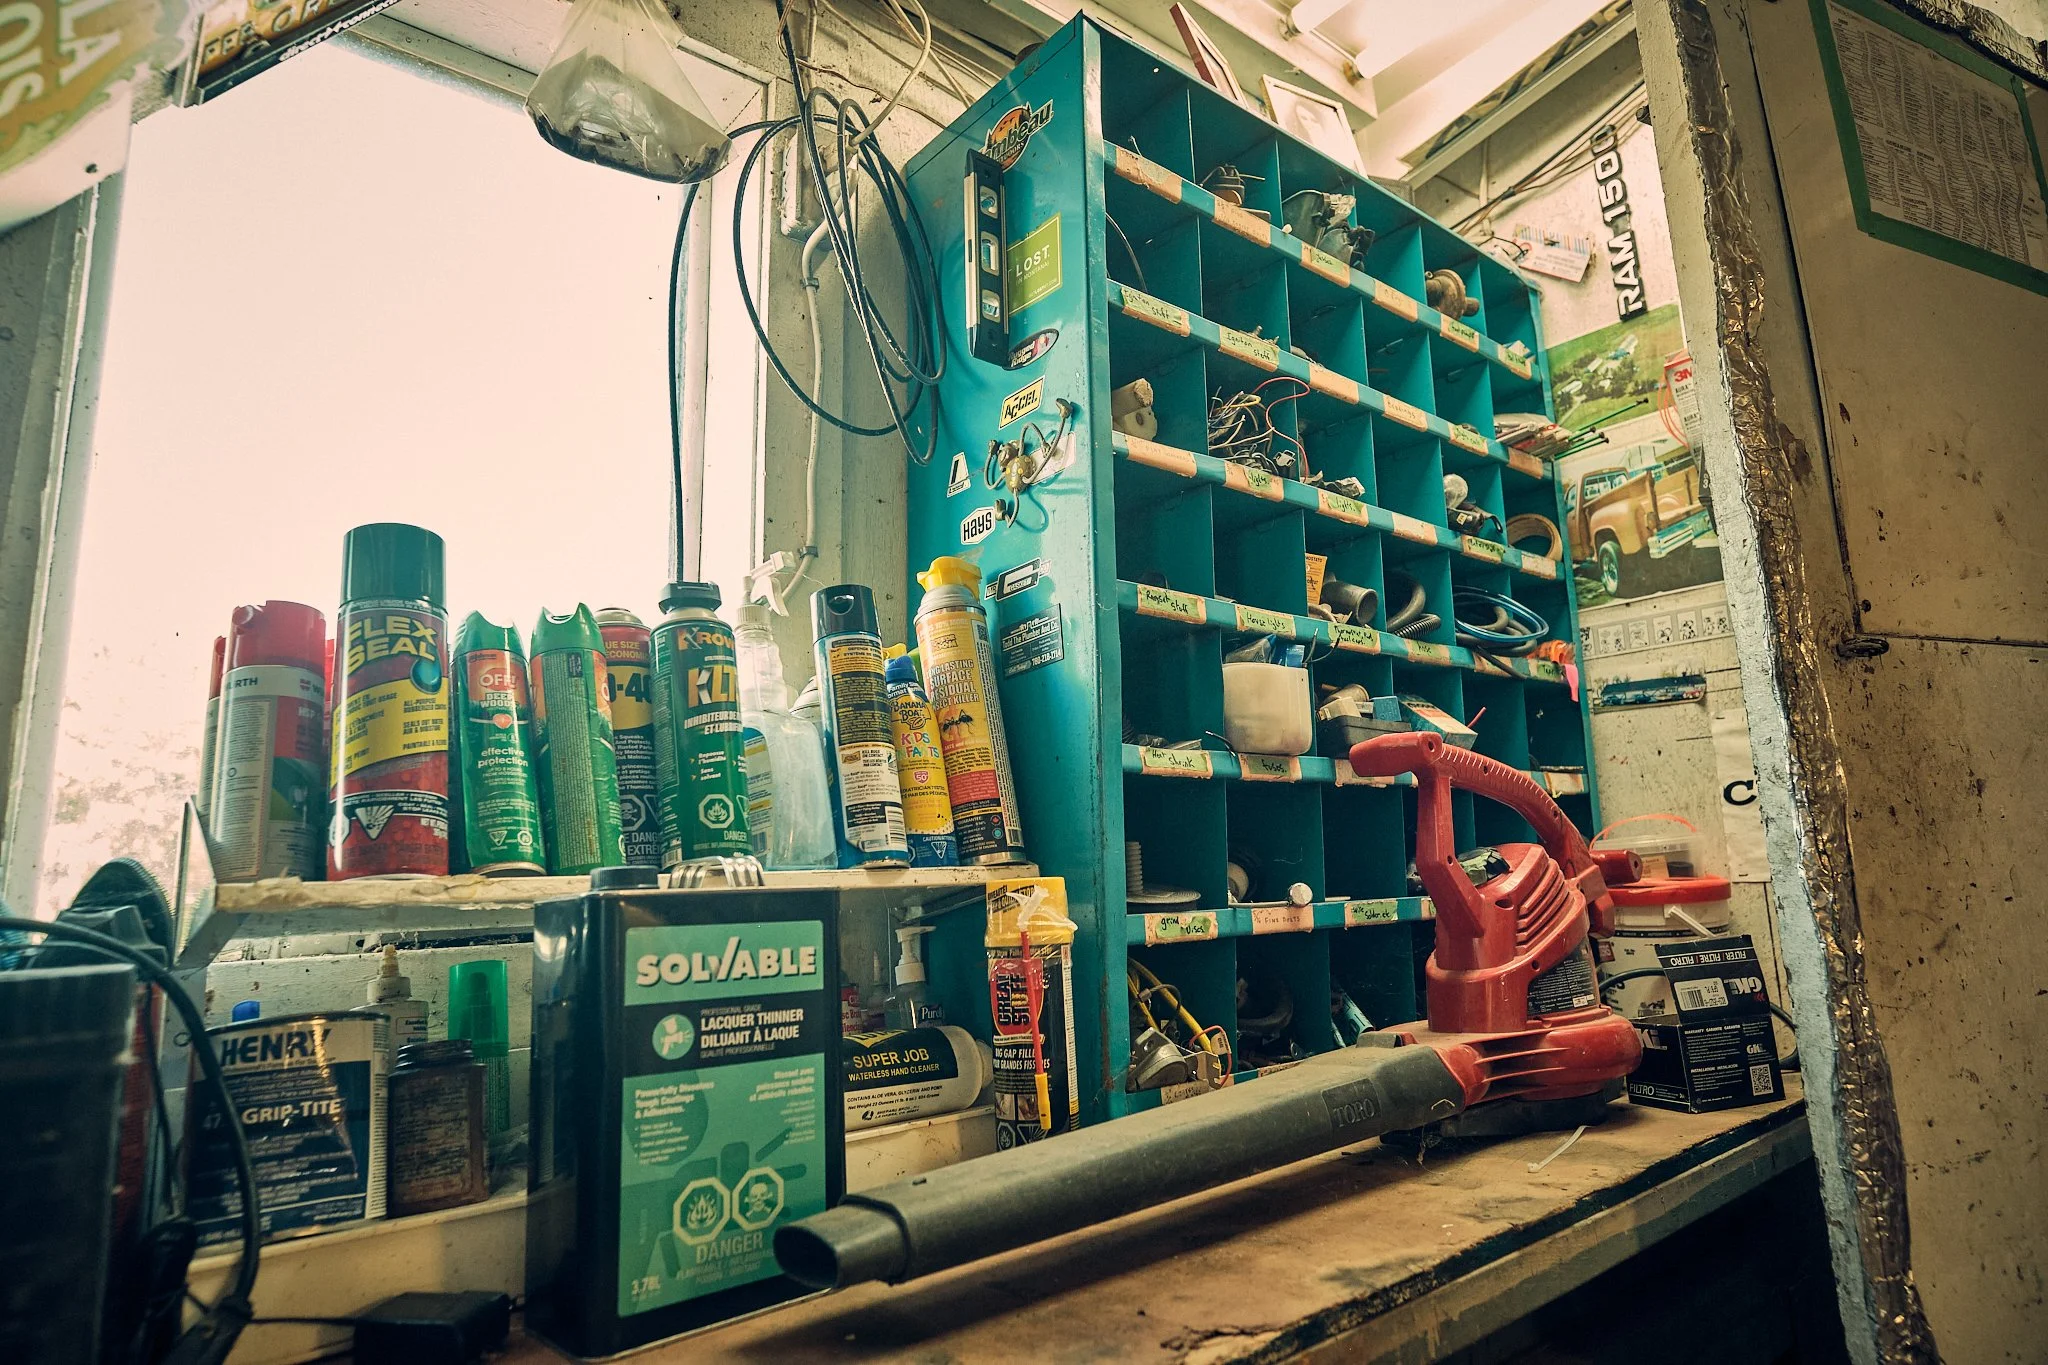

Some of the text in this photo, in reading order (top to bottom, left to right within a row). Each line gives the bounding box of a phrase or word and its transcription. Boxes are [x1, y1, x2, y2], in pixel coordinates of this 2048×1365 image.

[1608, 231, 1643, 316] RAM
[349, 615, 437, 646] FLEX
[620, 641, 641, 650] SIZE
[347, 637, 436, 676] SEAL
[941, 659, 974, 672] LASTING
[480, 673, 517, 688] OFF!
[931, 669, 972, 689] SURFACE
[887, 689, 907, 699] ormat
[888, 682, 909, 692] Family
[891, 700, 927, 712] BANANA
[954, 693, 980, 705] KILLER
[899, 709, 923, 721] BOAT
[481, 747, 525, 757] effective
[478, 757, 528, 768] protection
[724, 830, 747, 841] DANGER
[636, 936, 817, 986] SOLVABLE
[1671, 950, 1747, 966] FILTER FILTRE FILTRO
[701, 1008, 804, 1031] LACQUER THINNER
[701, 1025, 799, 1048] DILUANT À LAQUE
[222, 1029, 331, 1066] HENRY
[1004, 1048, 1017, 1058] GAP
[853, 1048, 930, 1069] SUPER JOB
[1001, 1060, 1023, 1070] GRANDES
[848, 1063, 940, 1082] WATERLESS HAND CLEANER
[1629, 1083, 1654, 1096] FILTRO
[847, 1094, 871, 1103] CONTAINS
[242, 1101, 342, 1125] GRIP-TITE
[696, 1231, 763, 1264] DANGER
